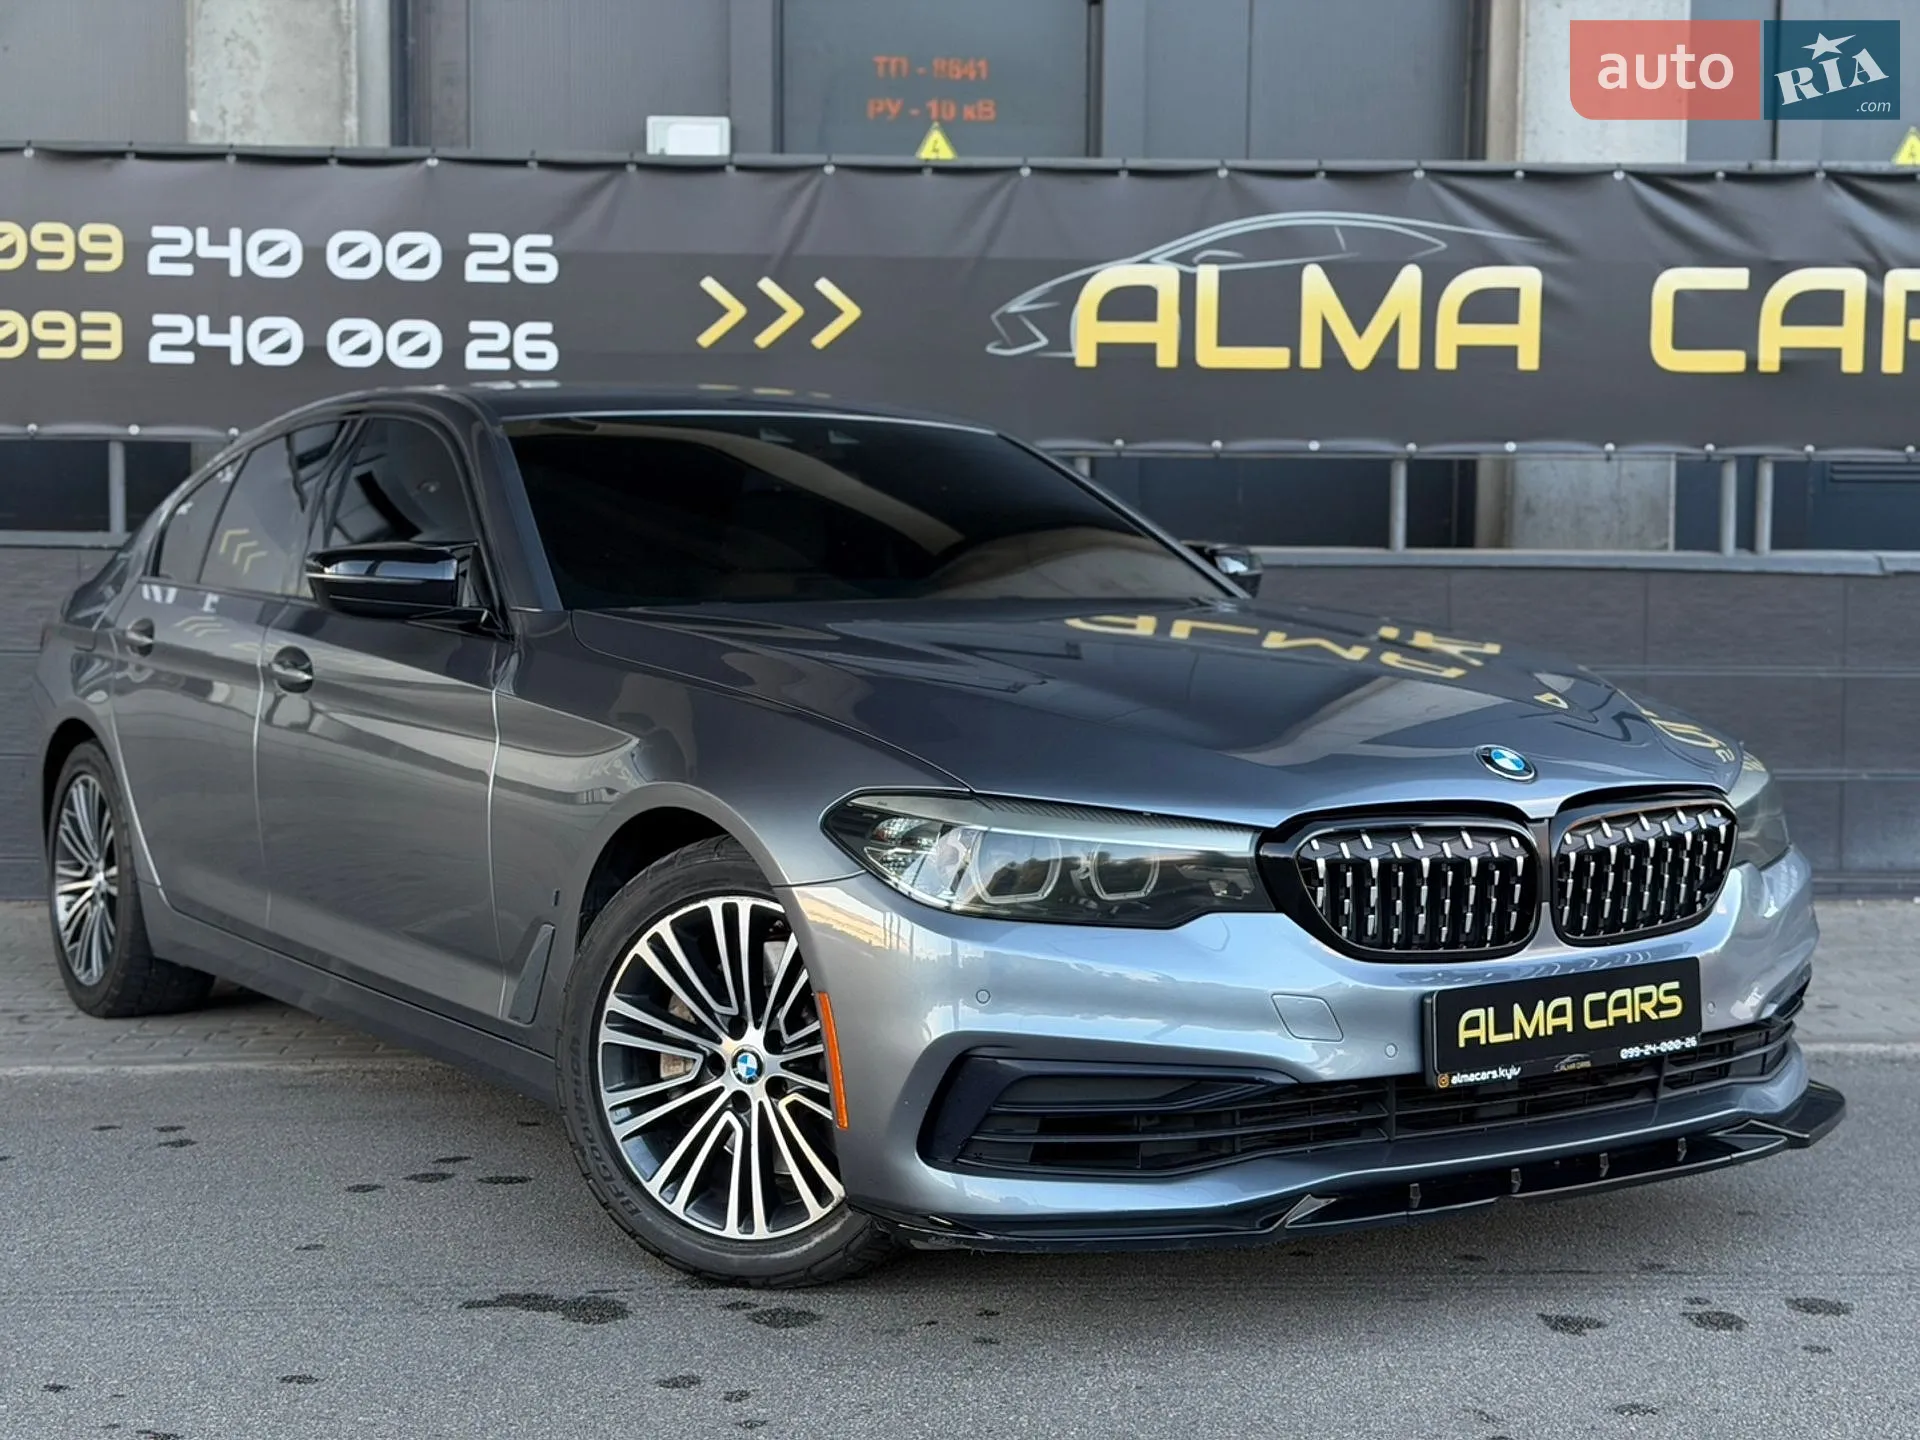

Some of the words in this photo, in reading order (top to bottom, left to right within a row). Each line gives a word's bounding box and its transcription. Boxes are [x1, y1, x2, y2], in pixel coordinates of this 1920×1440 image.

[926, 97, 957, 122] 10
[147, 225, 303, 278] 240
[326, 230, 442, 281] 00
[464, 232, 559, 284] 26
[148, 313, 304, 367] 240
[326, 318, 442, 369] 00
[464, 320, 559, 372] 26
[1074, 264, 1542, 371] ALMA
[1459, 997, 1573, 1048] ALMA
[1583, 981, 1683, 1030] CARS
